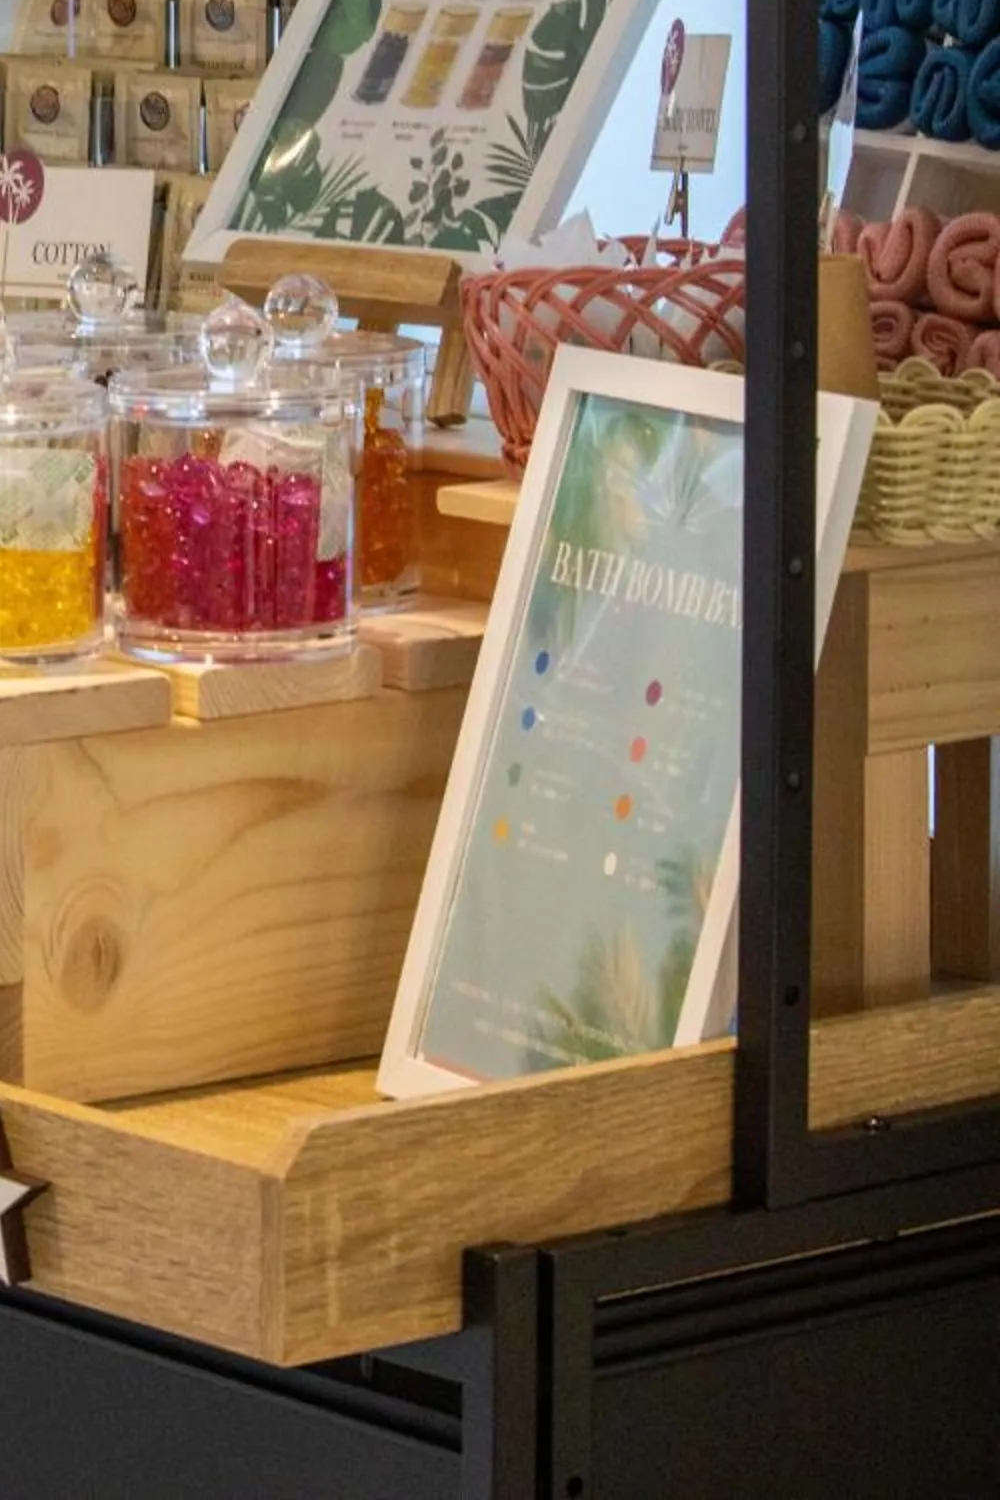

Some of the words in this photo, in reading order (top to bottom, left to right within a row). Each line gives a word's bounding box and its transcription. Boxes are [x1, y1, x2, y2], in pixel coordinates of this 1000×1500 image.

[550, 541, 626, 598] BATH
[624, 558, 707, 619] BOMB
[704, 578, 744, 630] BA
